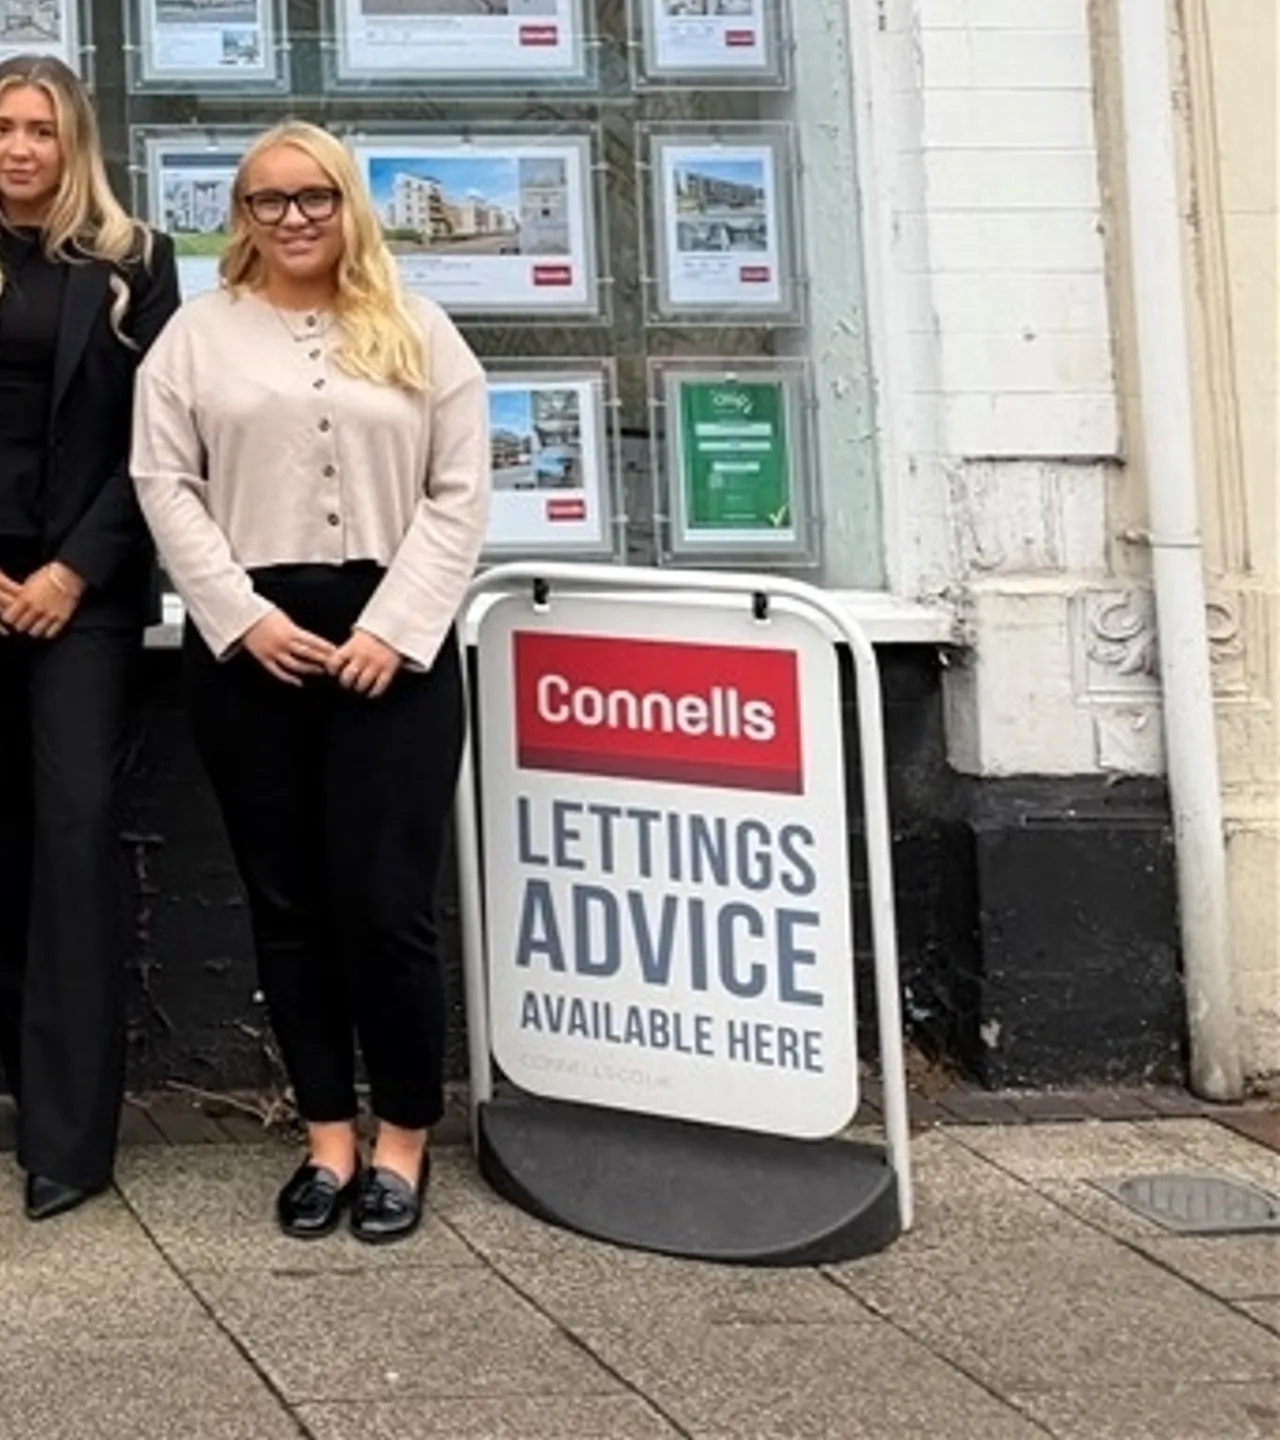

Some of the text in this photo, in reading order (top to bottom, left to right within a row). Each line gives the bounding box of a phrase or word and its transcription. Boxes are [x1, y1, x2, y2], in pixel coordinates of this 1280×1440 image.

[536, 674, 777, 742] Connells
[517, 796, 817, 898] LETTINGS
[515, 879, 824, 1007] ADVICE
[521, 992, 825, 1073] AVAILABLE HERE
